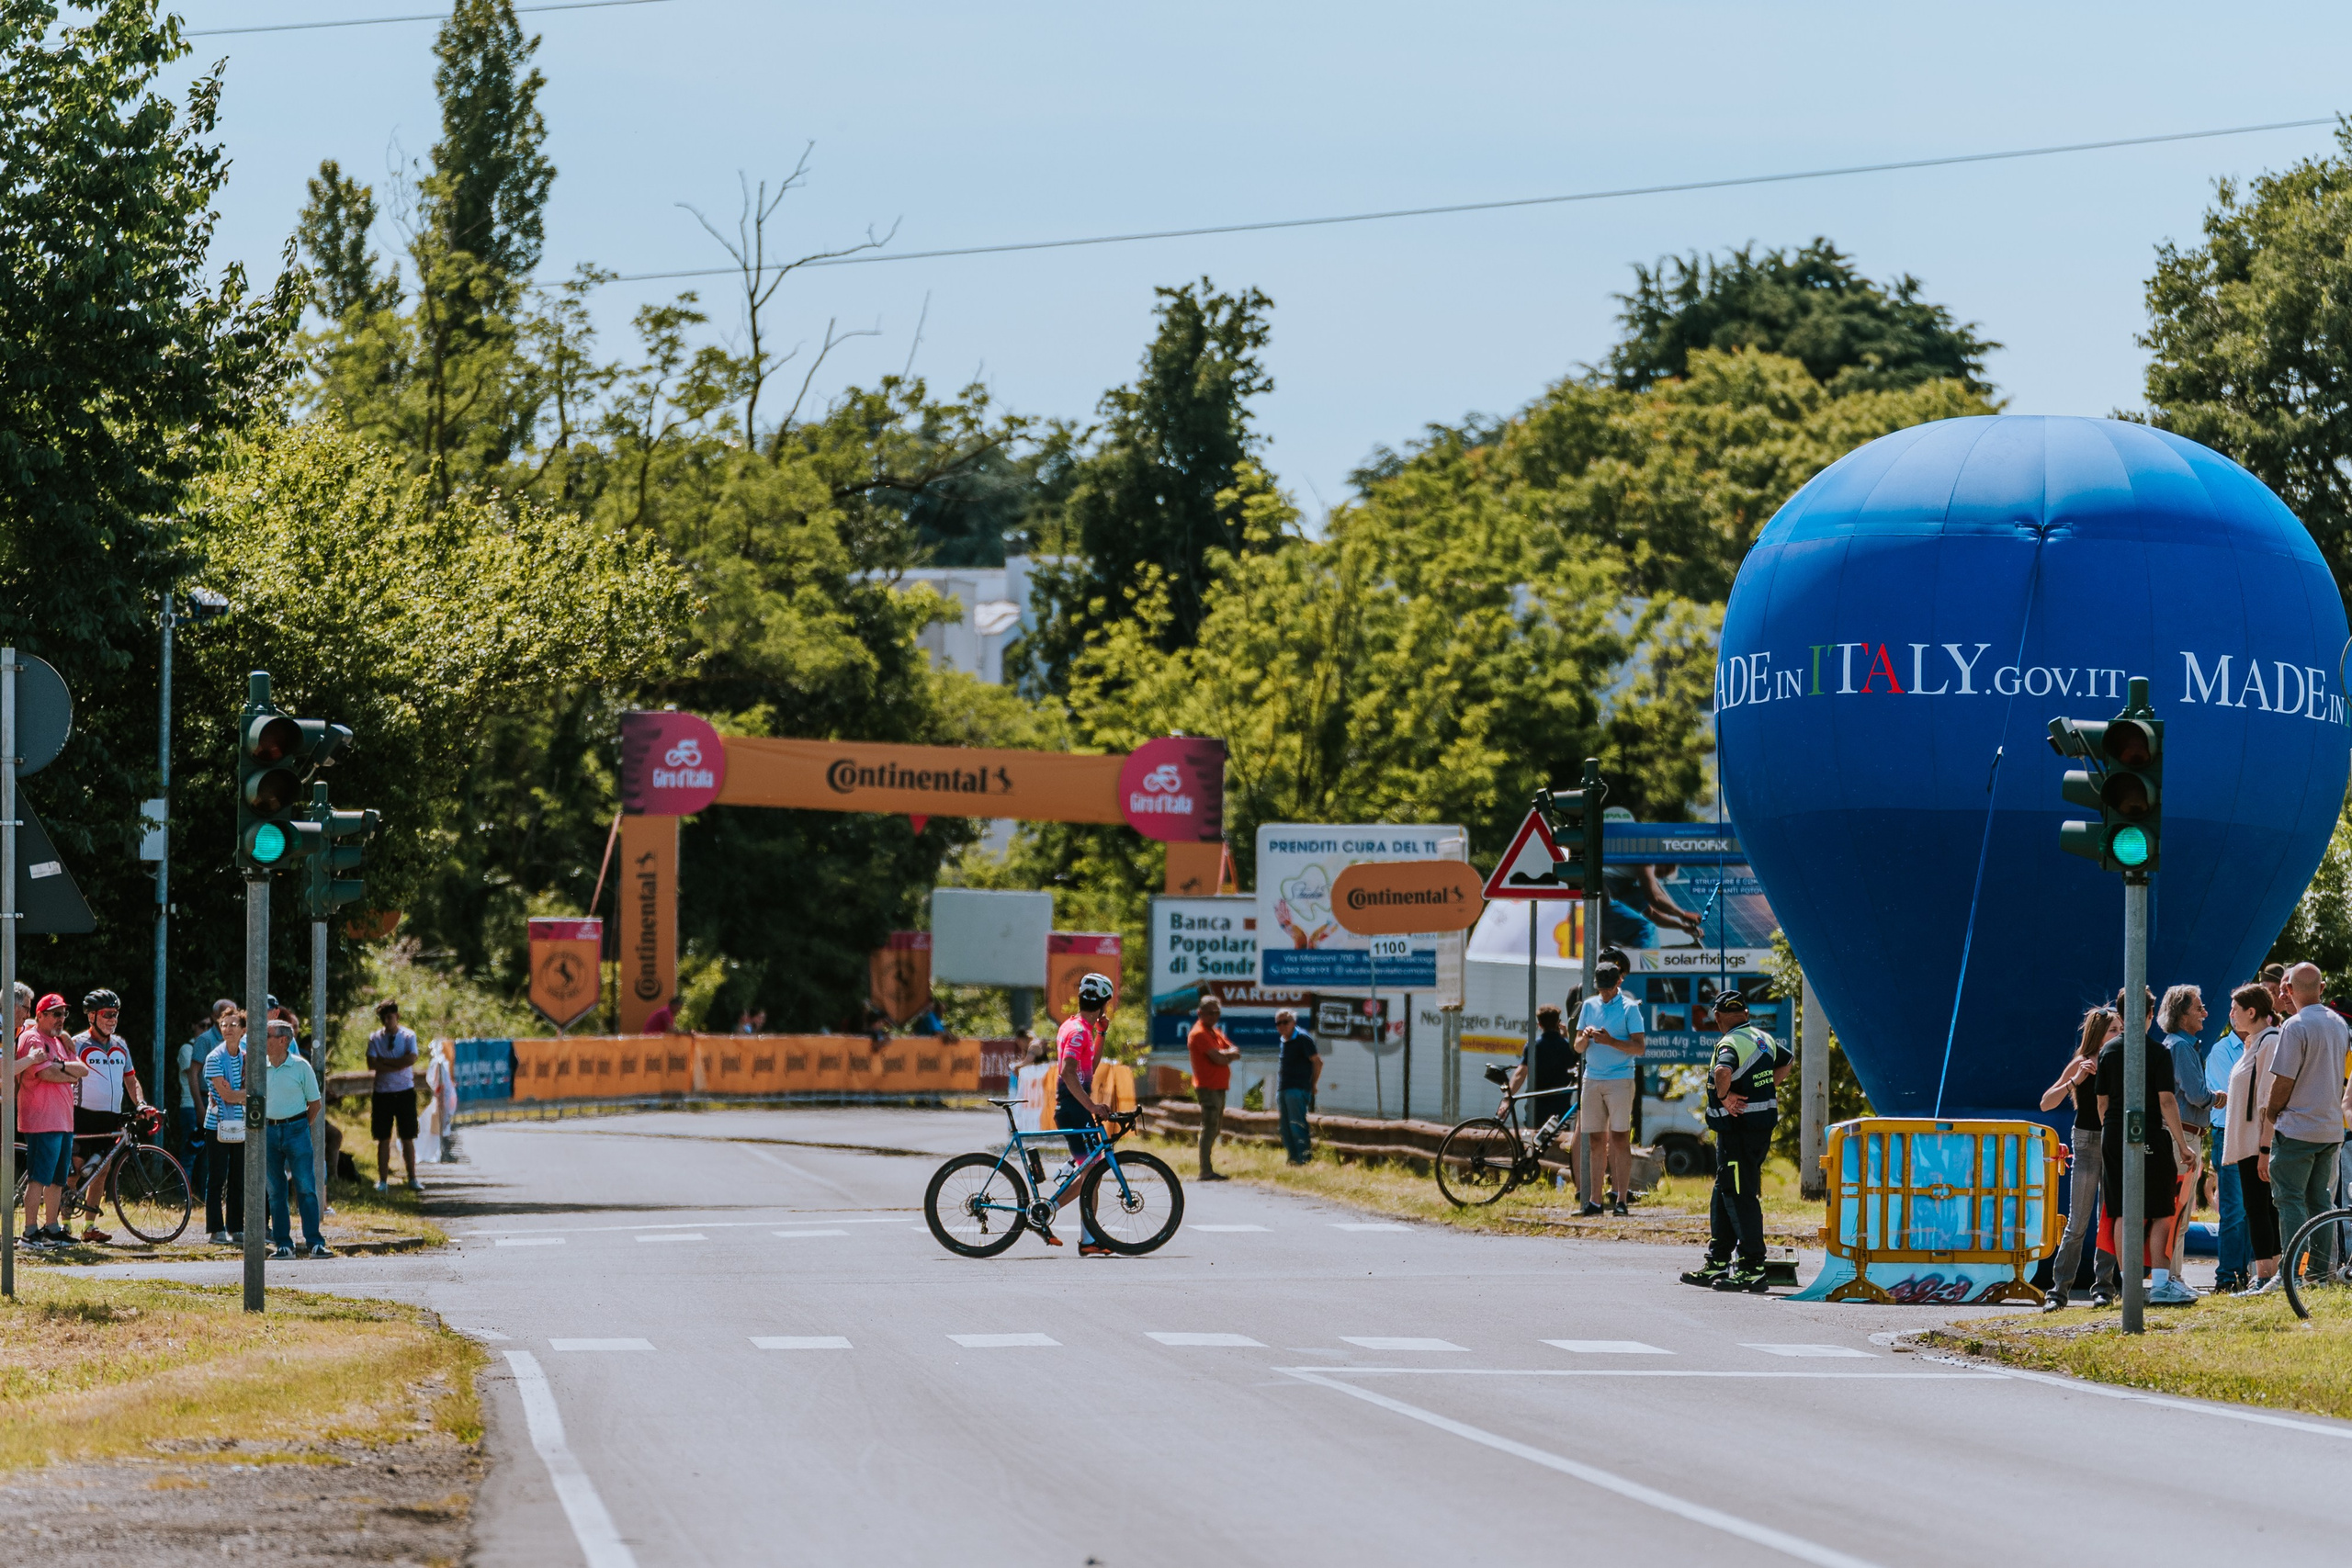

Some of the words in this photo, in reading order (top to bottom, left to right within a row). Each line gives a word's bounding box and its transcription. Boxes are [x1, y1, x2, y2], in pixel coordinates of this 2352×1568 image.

[1775, 668, 1804, 699] IN
[2179, 651, 2327, 721] MADE
[2329, 694, 2345, 725] IN
[652, 768, 675, 788] Giro
[827, 759, 987, 795] Continental
[1130, 792, 1154, 813] Giro
[1269, 840, 1338, 853] PRENDITI
[1342, 840, 1386, 853] CURA
[1392, 840, 1419, 853] DEL
[1347, 886, 1448, 910] Continental
[1170, 913, 1231, 931] Banca
[635, 872, 663, 1002] Continental
[1374, 941, 1407, 954] 1100
[1170, 956, 1188, 974] di
[1196, 956, 1256, 975] Sondr
[1664, 953, 1746, 968] solarfixings
[1420, 1011, 1490, 1031] Noggio
[1495, 1015, 1530, 1034] Furg
[1644, 1035, 1669, 1046] hetti
